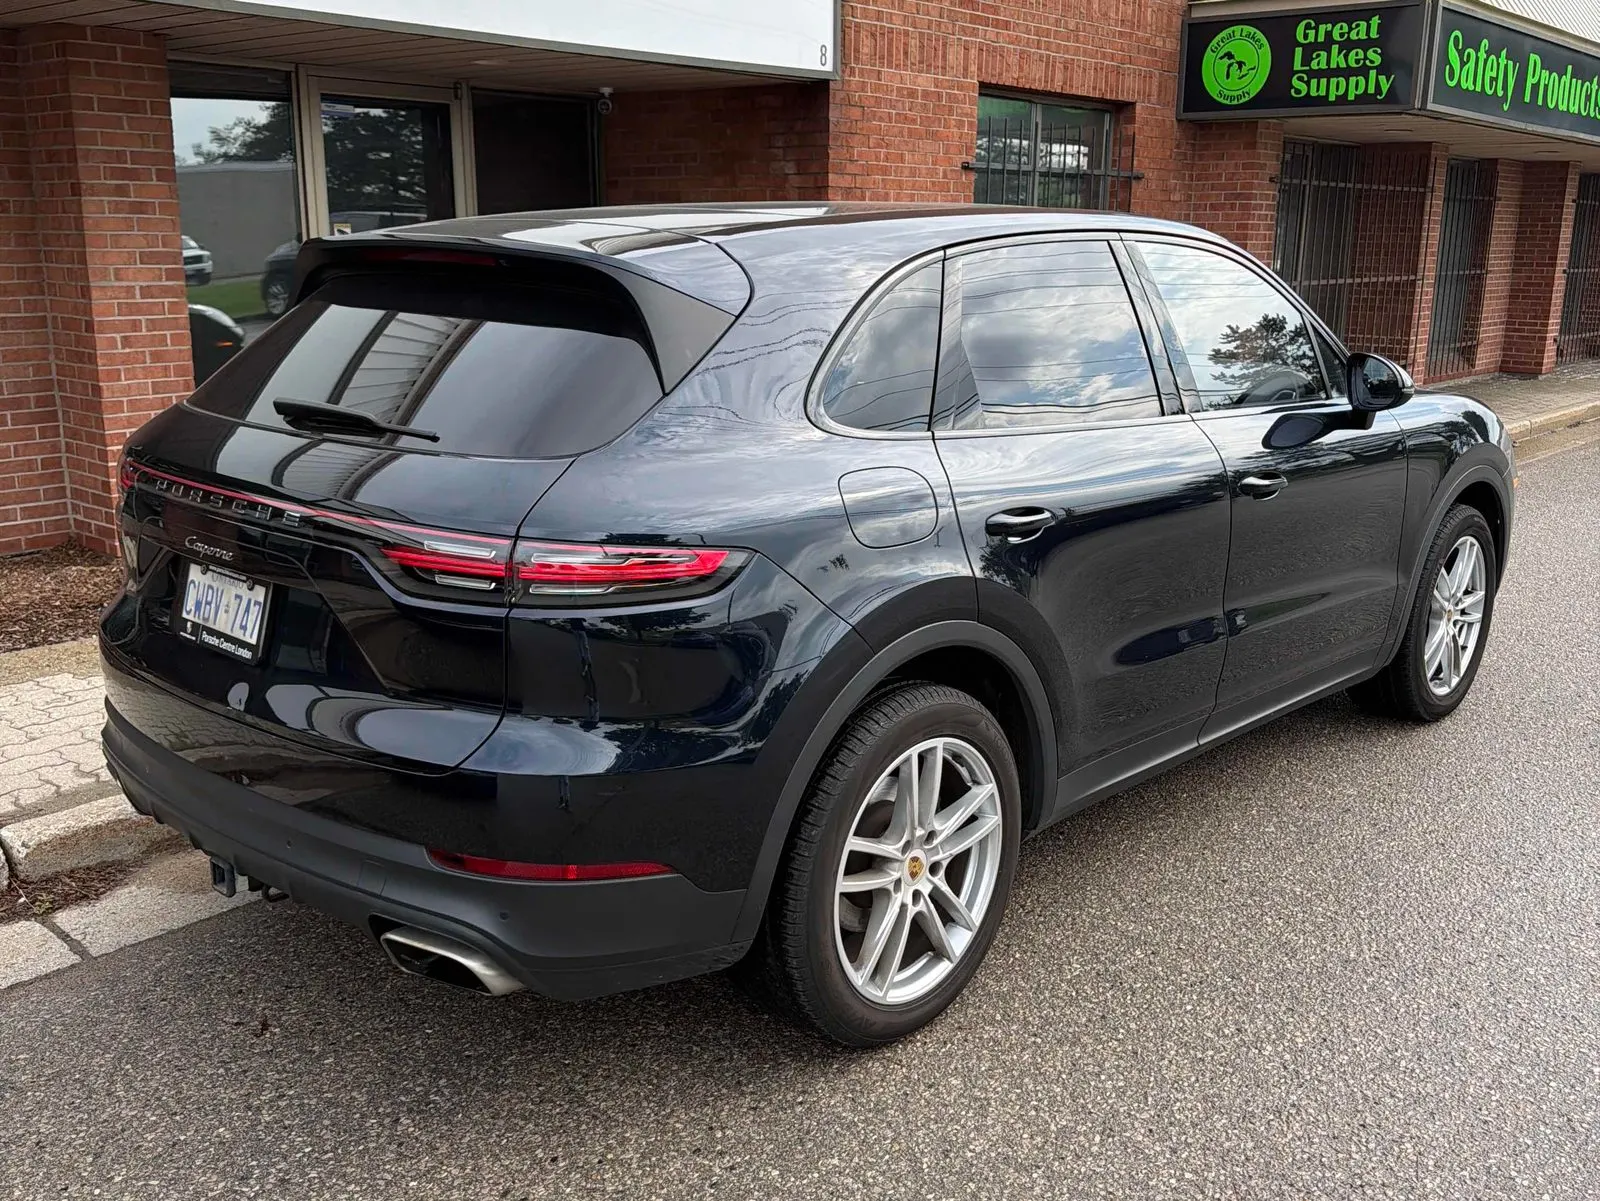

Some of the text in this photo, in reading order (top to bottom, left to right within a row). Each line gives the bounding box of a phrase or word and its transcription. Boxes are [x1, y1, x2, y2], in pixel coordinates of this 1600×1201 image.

[1210, 28, 1265, 54] Great Lakes
[1296, 15, 1382, 43] Great
[820, 44, 827, 67] 8
[1293, 44, 1382, 71] Lakes
[1290, 69, 1395, 101] Supply
[1445, 30, 1520, 112] Safety
[1217, 89, 1251, 103] Supply
[155, 479, 301, 527] PORSCHE
[184, 536, 234, 561] Cayenne
[230, 594, 263, 639] 747
[202, 631, 220, 647] Porsche
[235, 644, 253, 660] London
